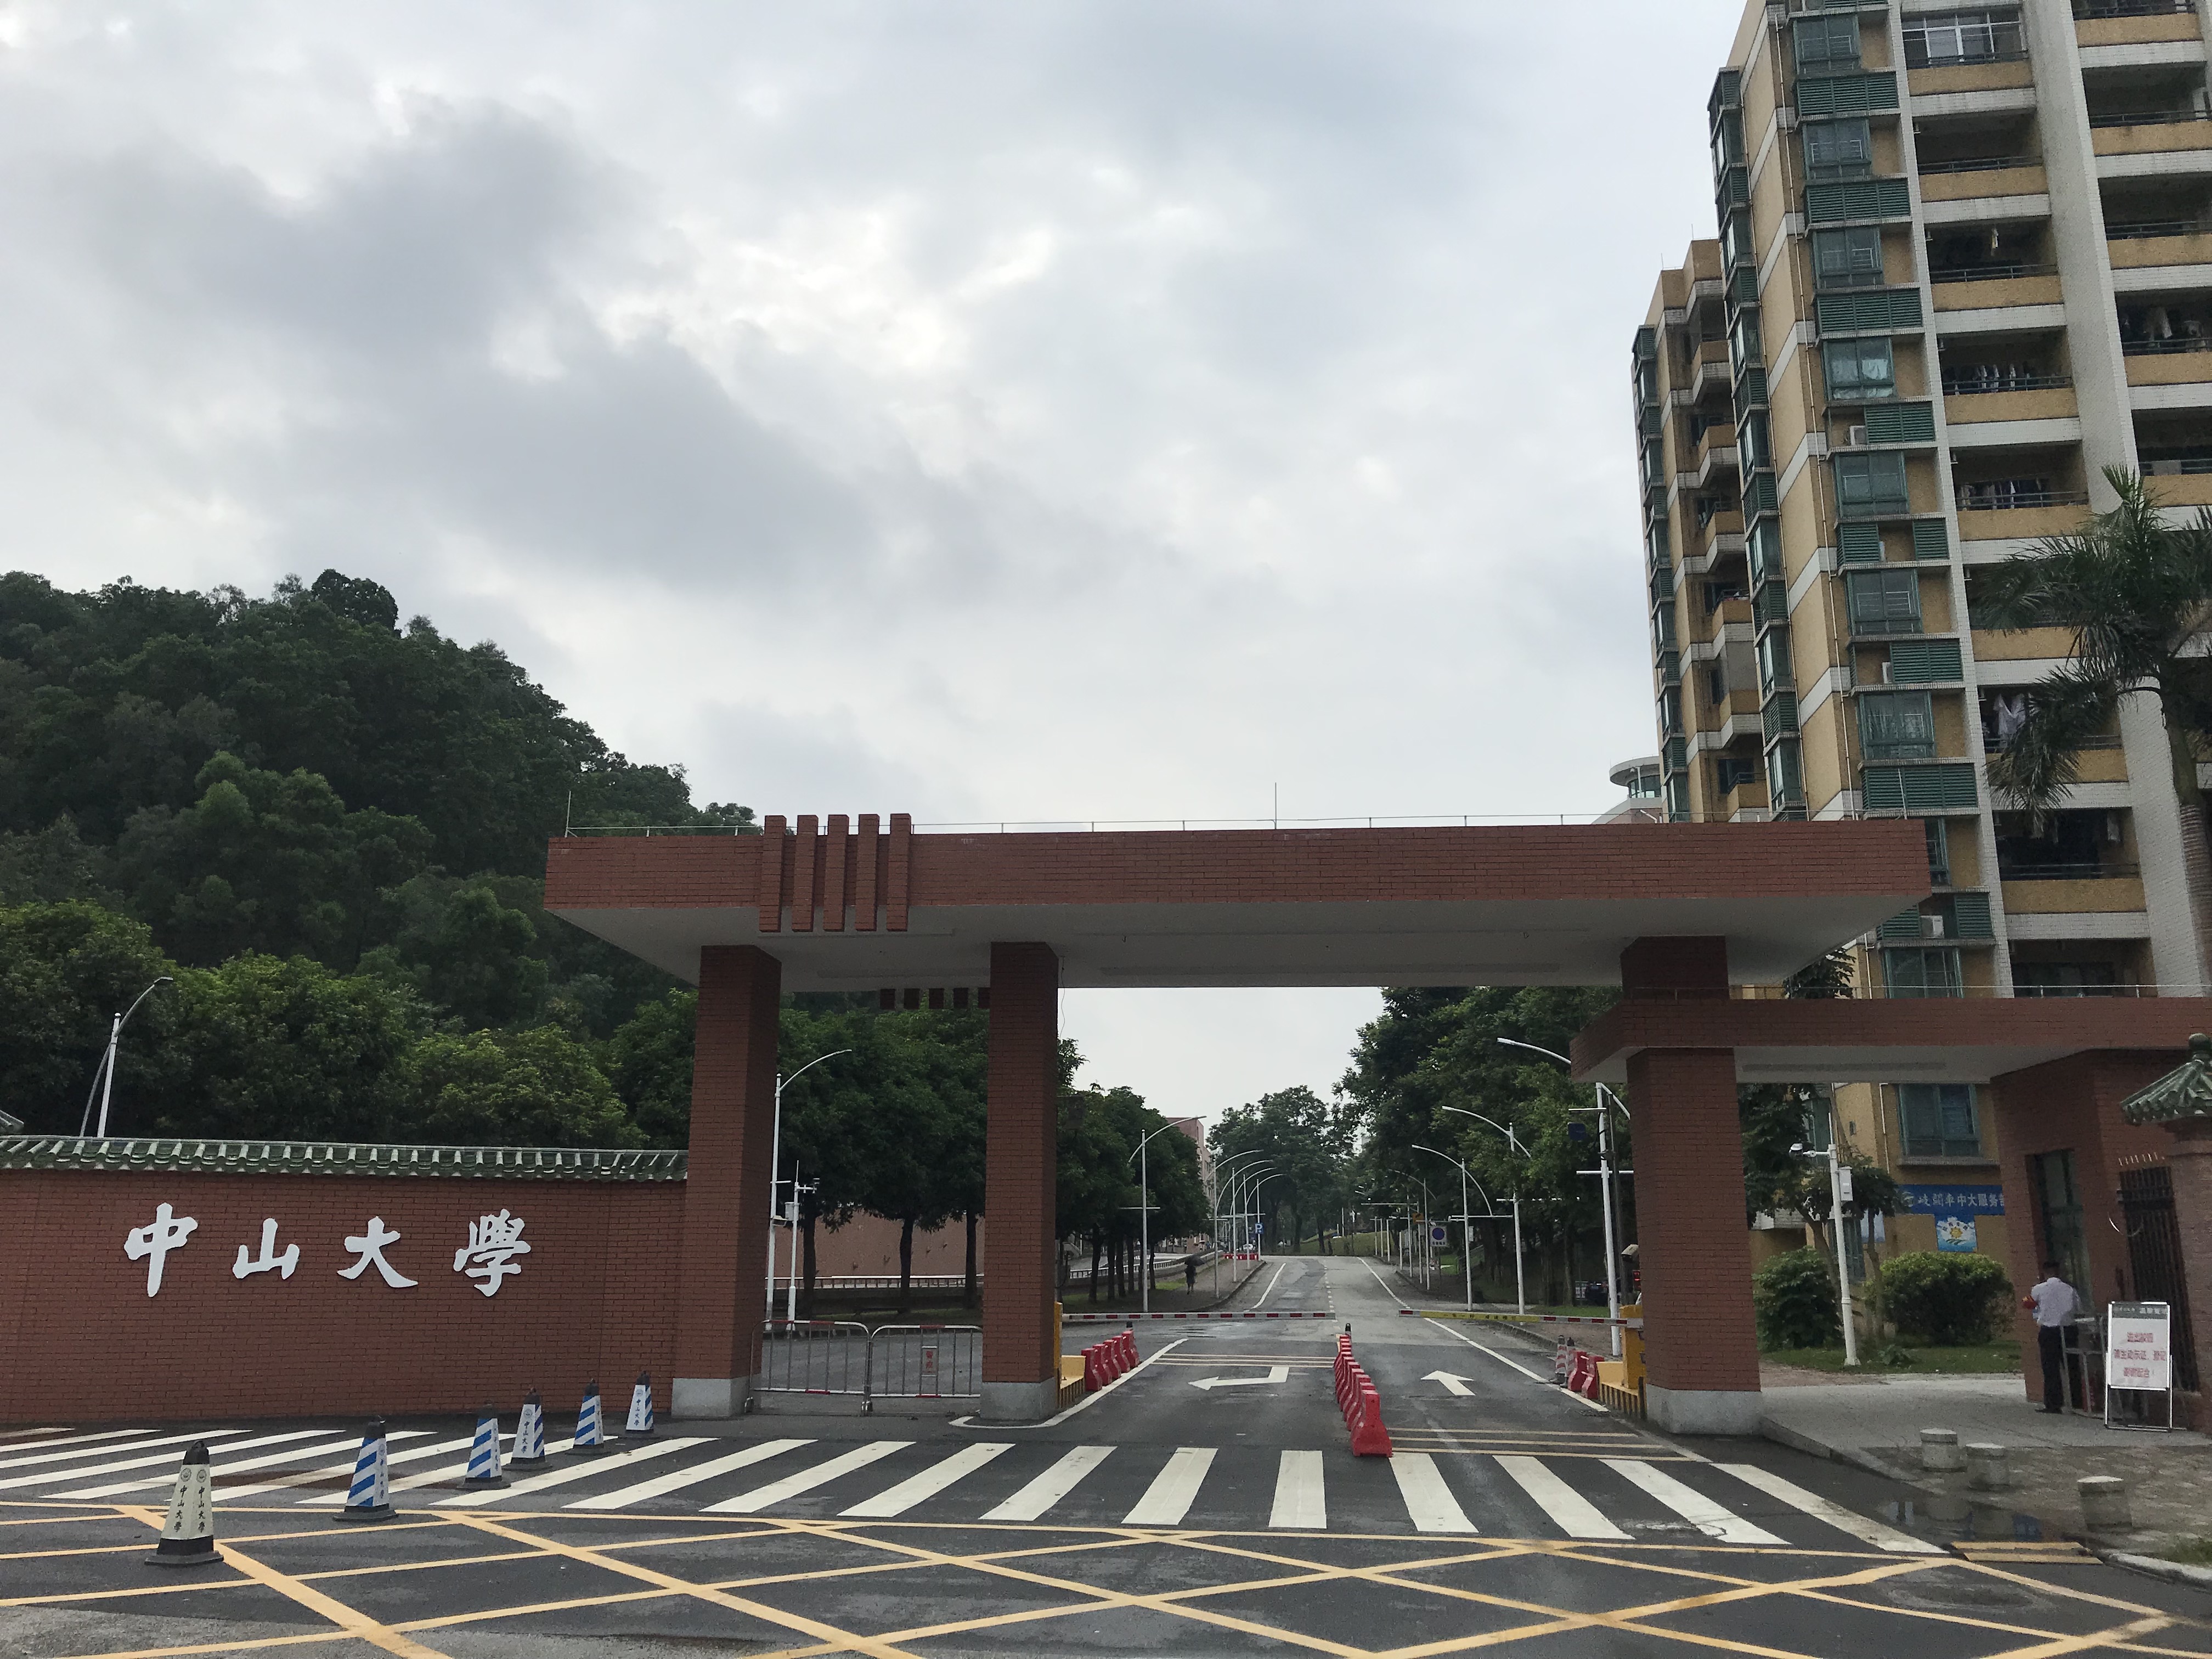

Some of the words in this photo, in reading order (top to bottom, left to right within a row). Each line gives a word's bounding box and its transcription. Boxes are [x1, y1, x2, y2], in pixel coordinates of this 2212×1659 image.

[123, 1203, 531, 1297] 中山大學
[1255, 1223, 1263, 1233] P
[174, 1485, 187, 1532] 中山大學
[198, 1486, 206, 1533] 中山大學
